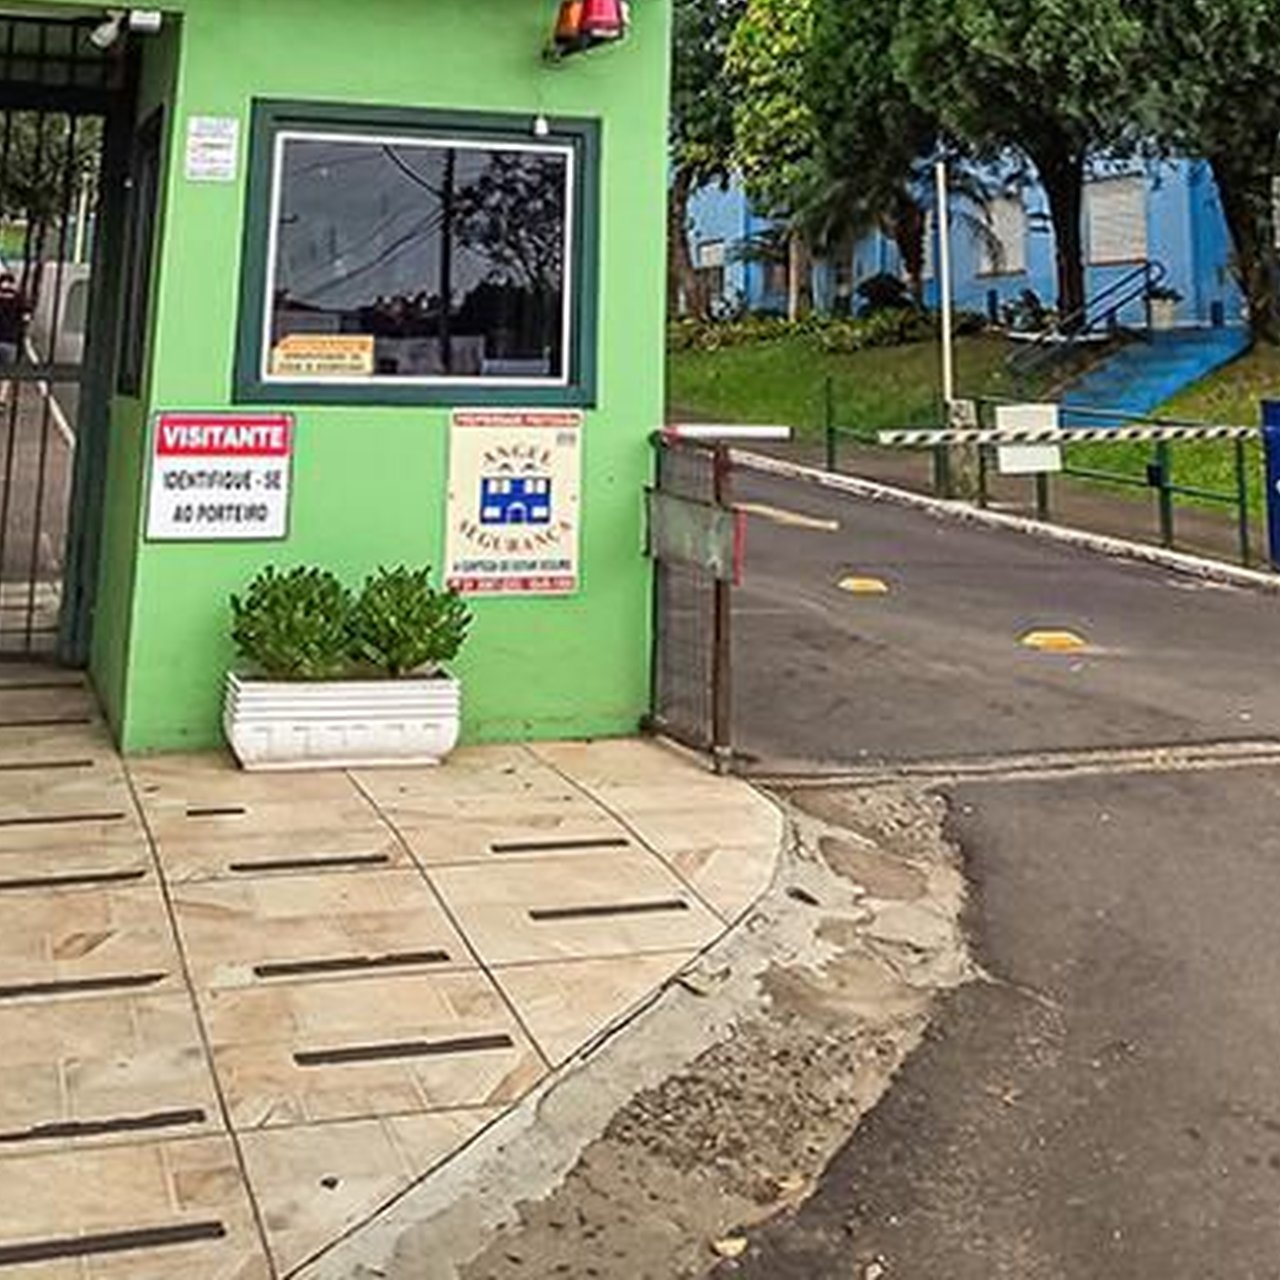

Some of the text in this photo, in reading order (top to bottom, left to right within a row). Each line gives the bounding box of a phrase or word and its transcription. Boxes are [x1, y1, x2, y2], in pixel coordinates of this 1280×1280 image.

[162, 424, 285, 448] VISITANTE
[172, 503, 268, 523] AO PORTEIRO
